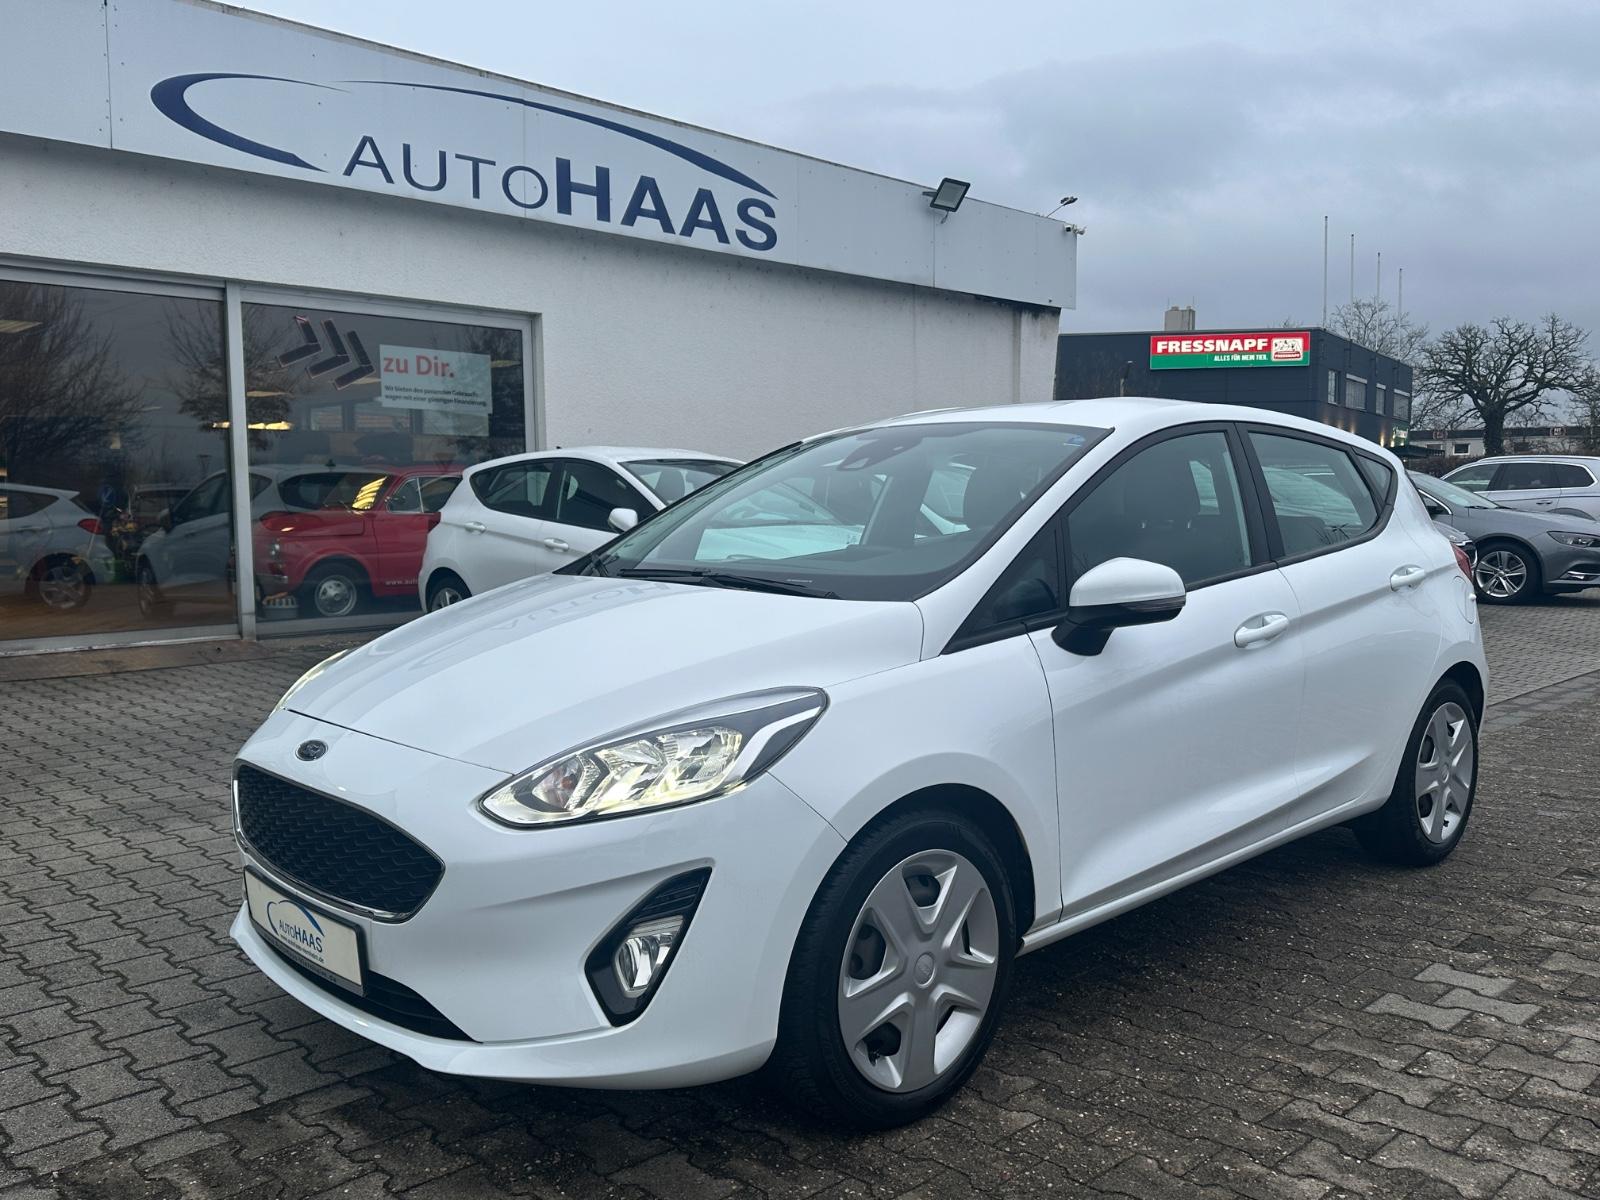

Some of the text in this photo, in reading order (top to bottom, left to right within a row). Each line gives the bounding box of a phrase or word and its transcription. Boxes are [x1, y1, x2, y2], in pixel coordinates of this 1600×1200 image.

[1156, 338, 1268, 353] FRESSNAPF
[1231, 353, 1241, 361] FÜR
[383, 355, 455, 378] zu Dir.
